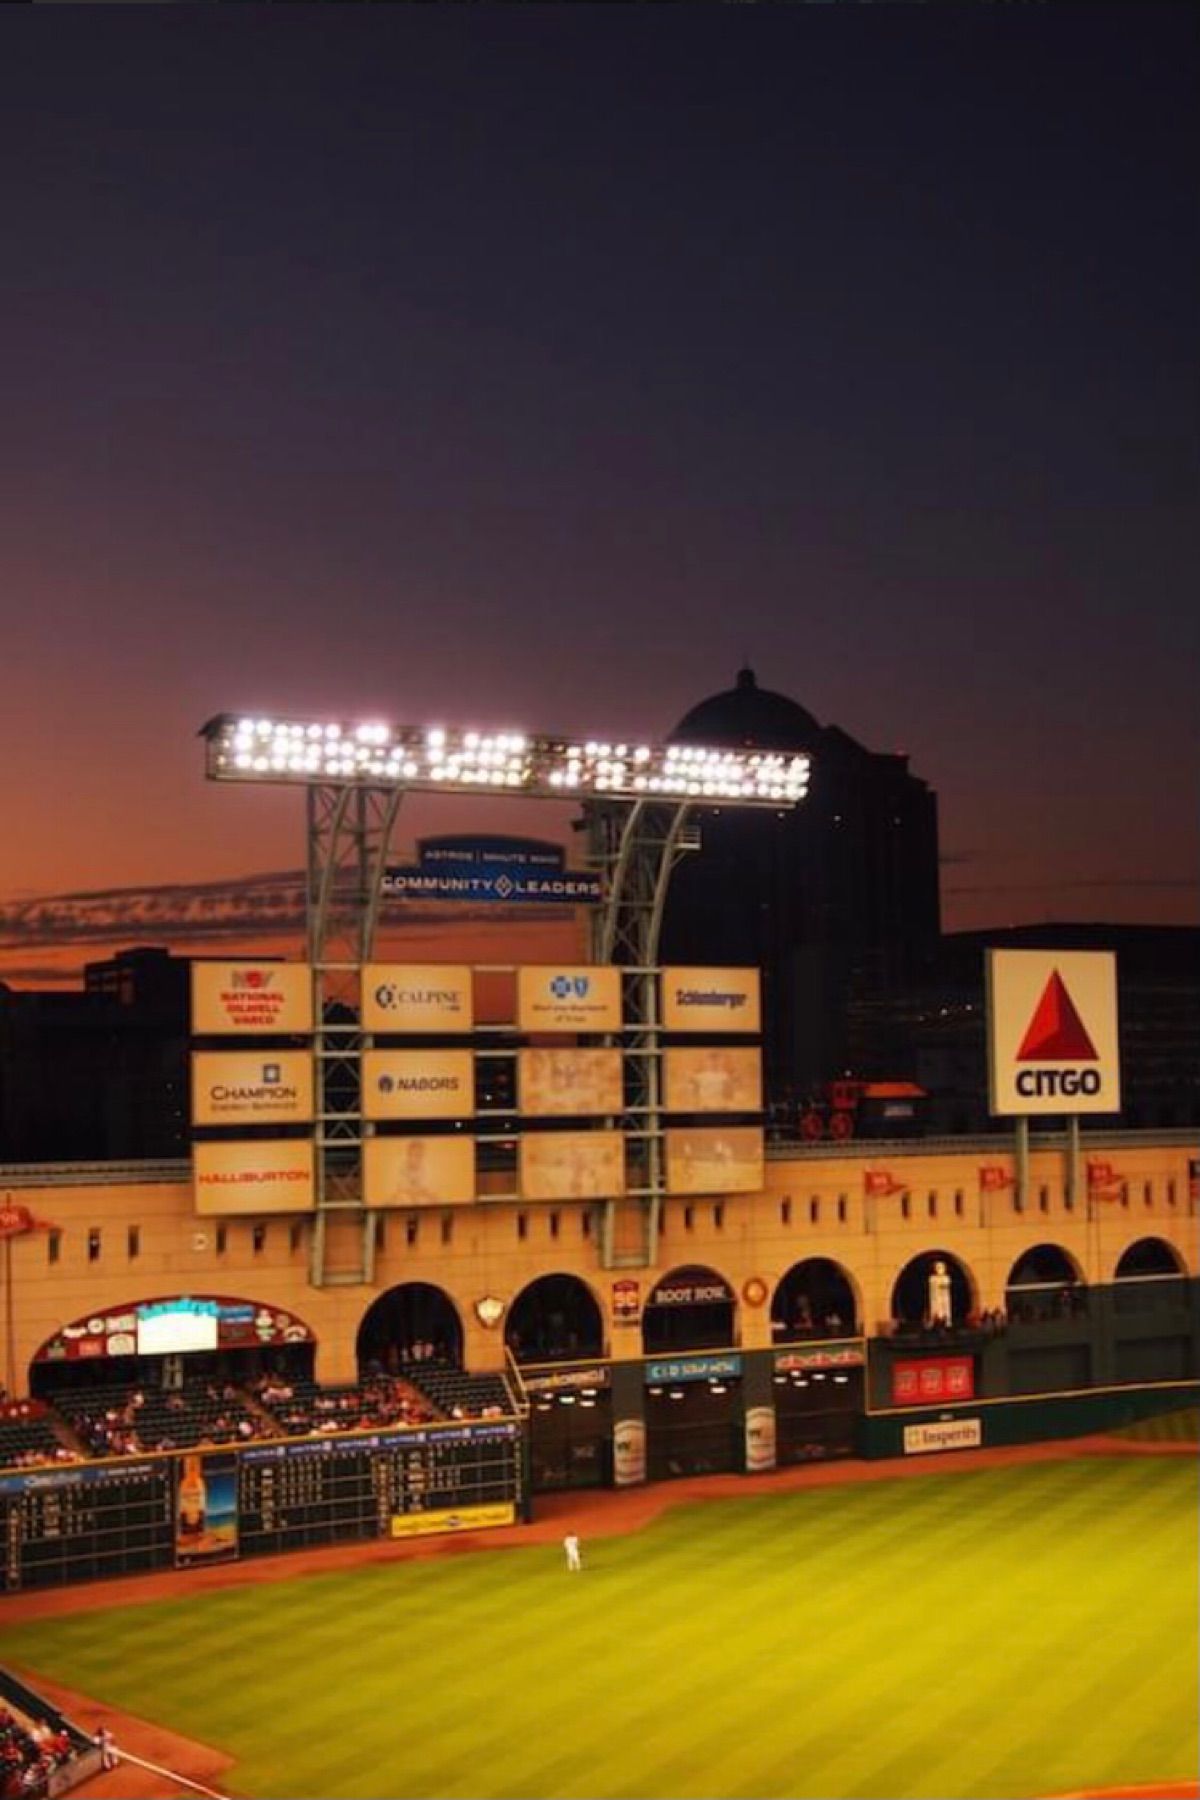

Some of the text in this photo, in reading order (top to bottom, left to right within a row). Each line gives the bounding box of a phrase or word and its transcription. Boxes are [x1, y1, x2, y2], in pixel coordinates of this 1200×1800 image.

[381, 876, 600, 895] COMMUNITY LEADERS
[220, 992, 285, 1003] NATIONAL
[398, 989, 461, 1004] CALPINE
[397, 1076, 460, 1091] NABORS
[1015, 1068, 1102, 1097] CITGO
[210, 1085, 297, 1101] CHAMPION
[198, 1170, 310, 1185] HALLIBURTON
